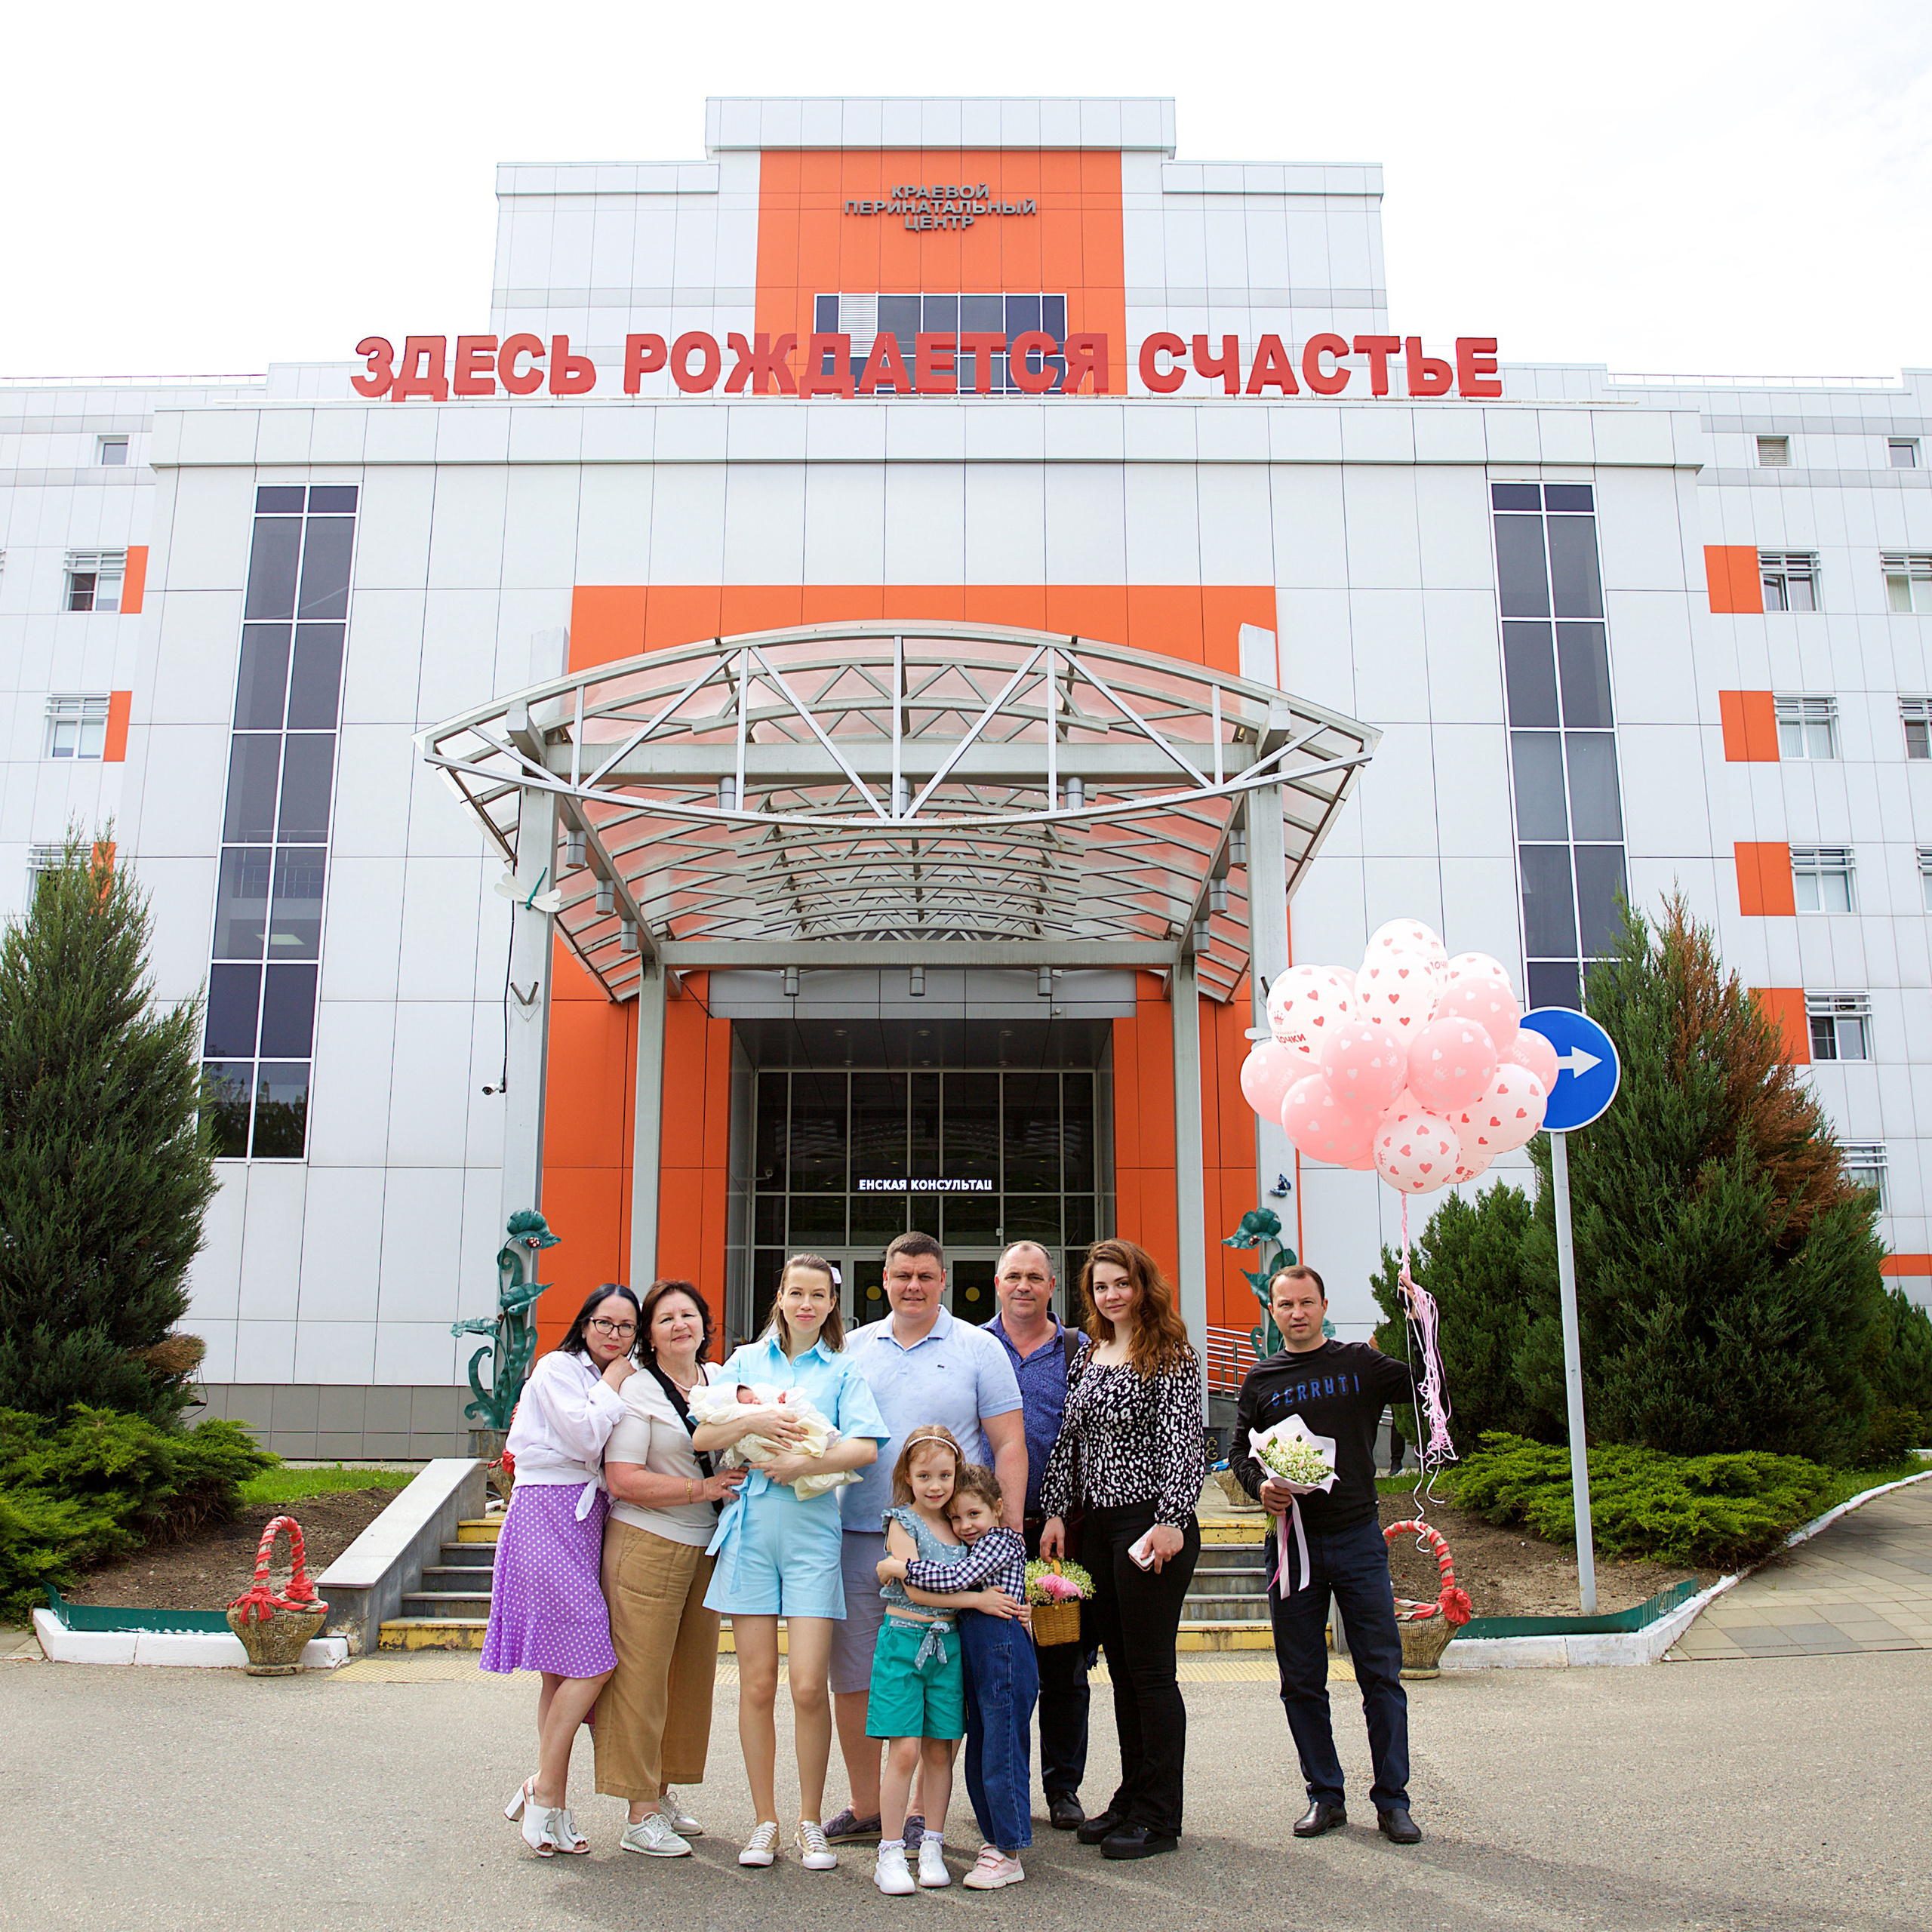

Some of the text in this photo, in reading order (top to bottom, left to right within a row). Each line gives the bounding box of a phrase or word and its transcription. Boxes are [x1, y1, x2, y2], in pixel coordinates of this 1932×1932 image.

[891, 183, 989, 199] КРАЕВОЙ
[844, 198, 1037, 215] ПЕРИНАТАЛЬНЫЙ
[905, 215, 975, 232] ЦЕНТР
[350, 331, 1503, 402] ЗДЕСЬ РОЖДАЕТСЯ СЧАСТЬЕ
[858, 1179, 907, 1190] ЕНСКАЯ
[1271, 1374, 1360, 1406] CERRUTI
